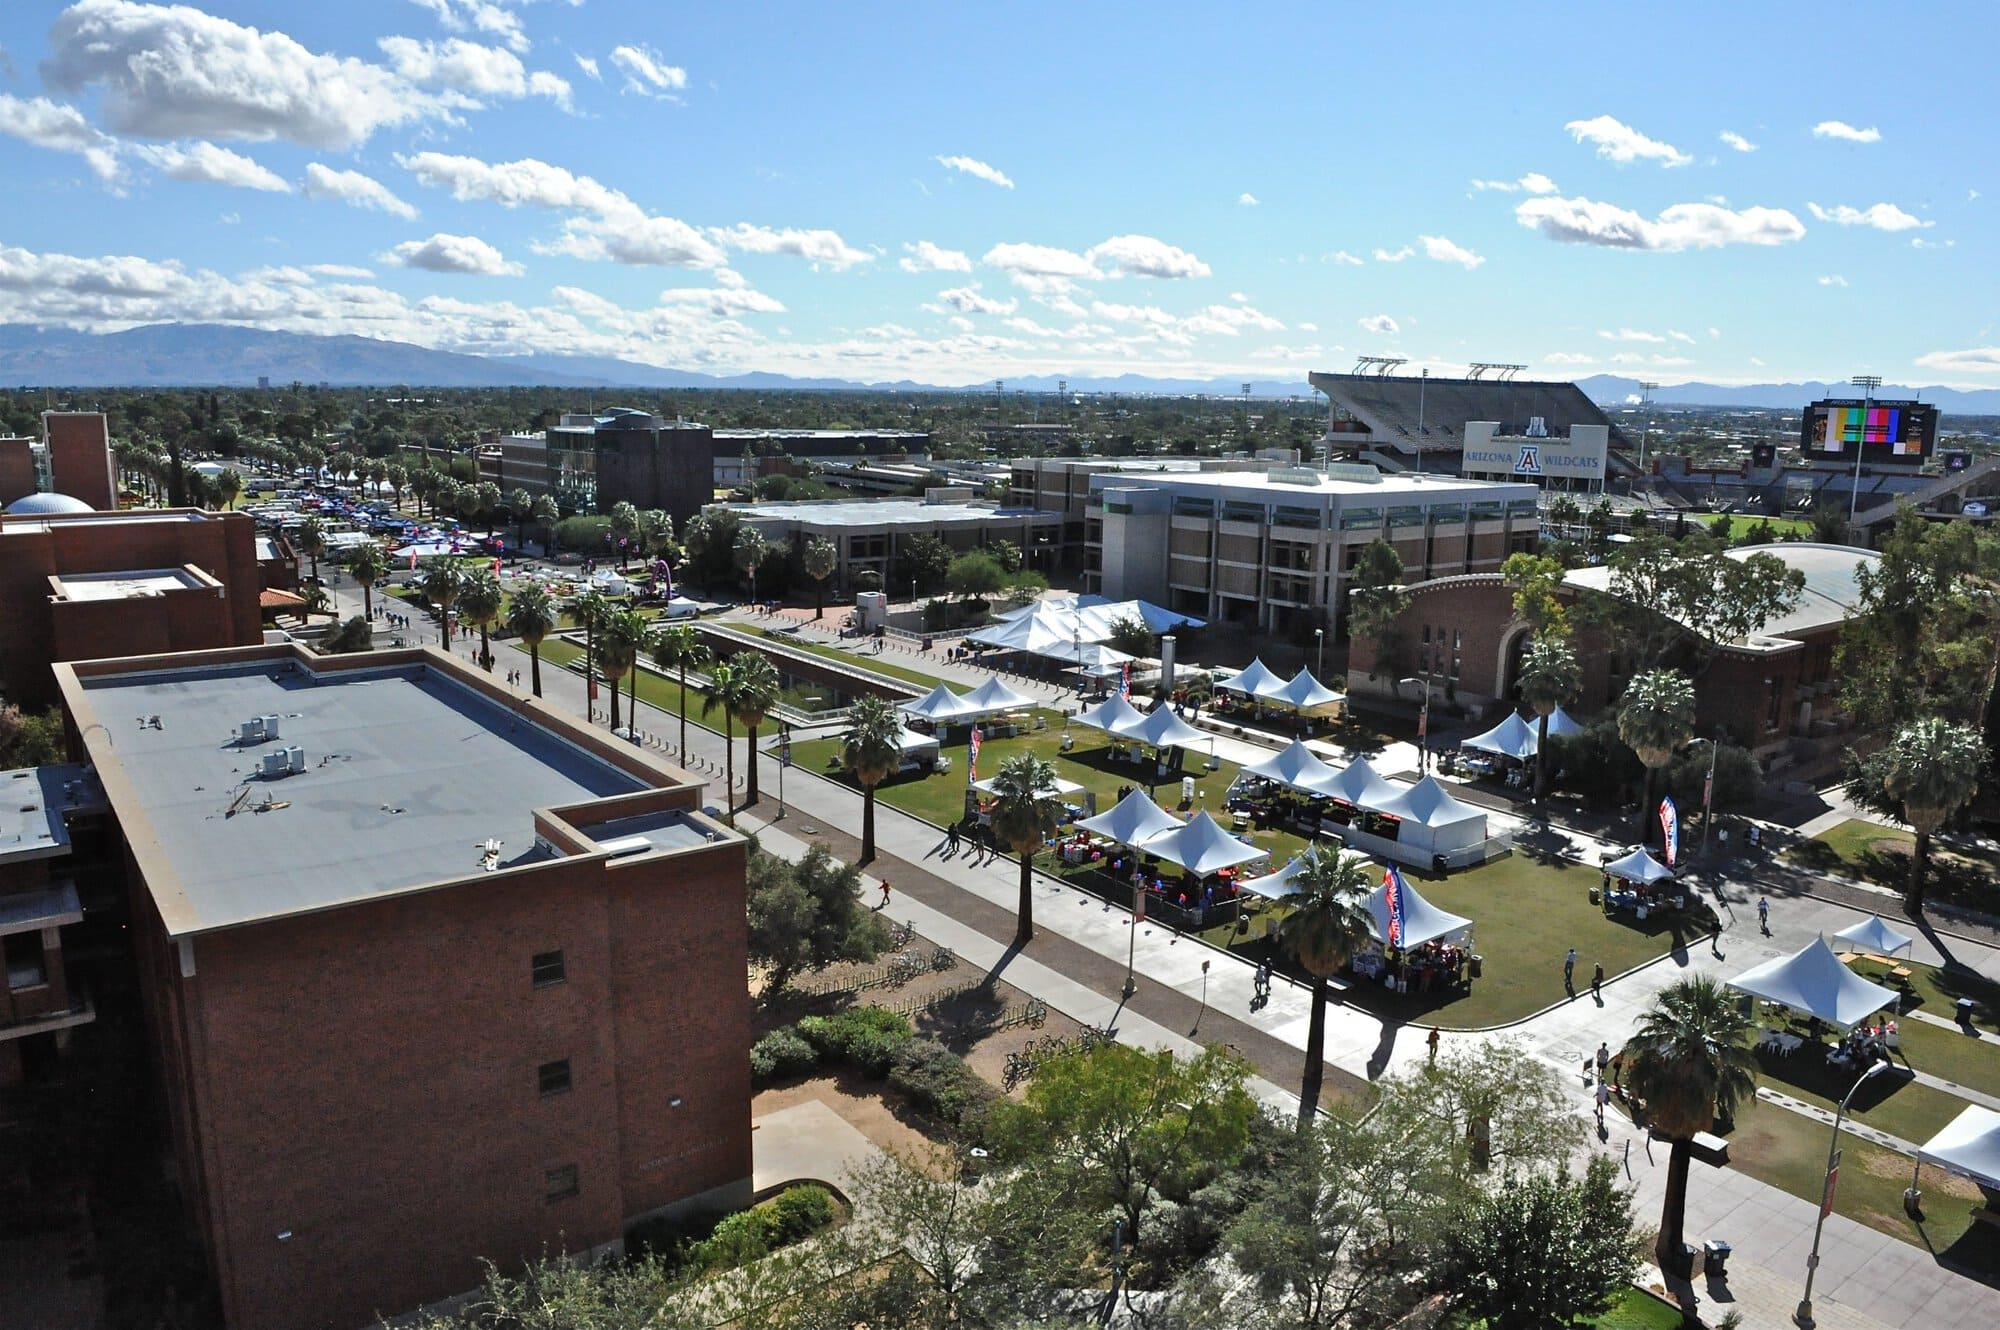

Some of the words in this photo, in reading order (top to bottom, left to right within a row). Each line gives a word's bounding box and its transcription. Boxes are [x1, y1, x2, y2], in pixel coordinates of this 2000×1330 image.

[1465, 452, 1513, 464] ARIZONA
[1514, 446, 1542, 473] A
[1544, 455, 1599, 468] WILDCATS
